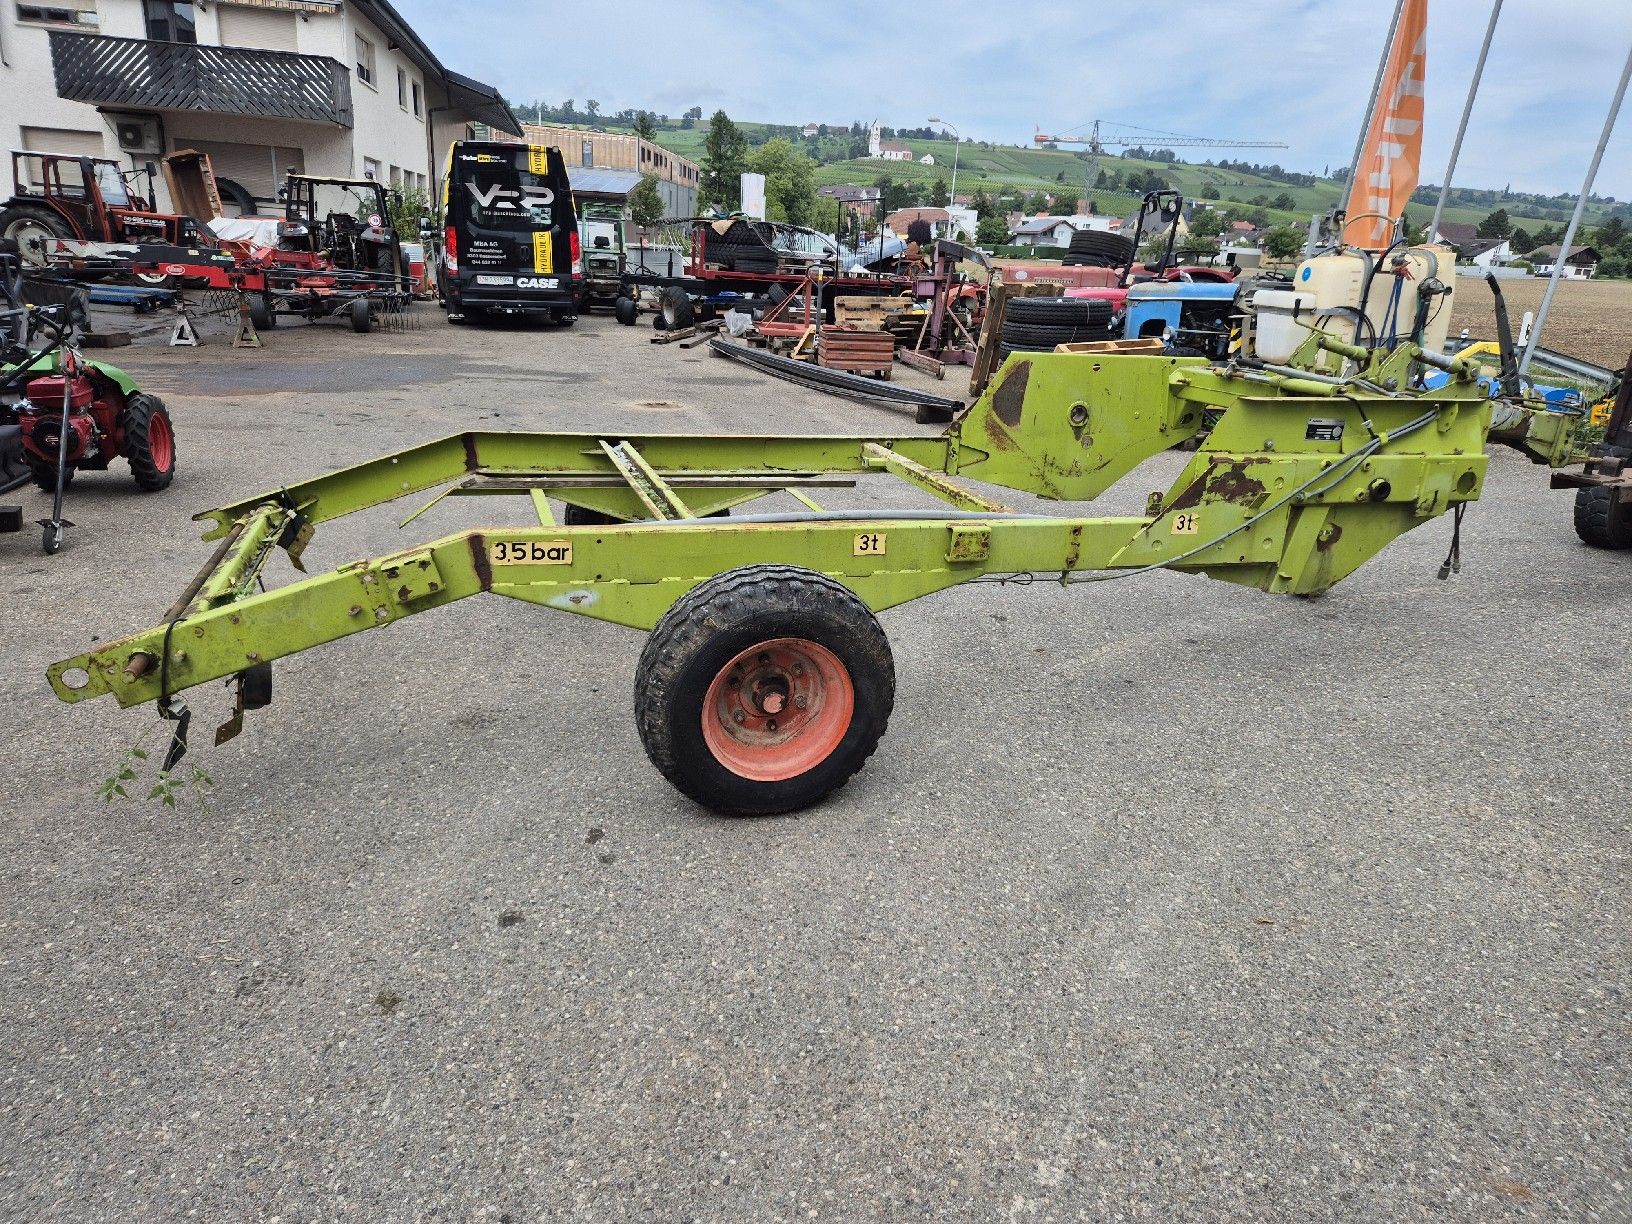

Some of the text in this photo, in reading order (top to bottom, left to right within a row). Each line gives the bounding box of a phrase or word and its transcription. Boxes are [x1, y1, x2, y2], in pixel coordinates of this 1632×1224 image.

[539, 232, 547, 272] HYDRAULIK
[516, 277, 559, 289] CASE
[1176, 514, 1193, 531] 3t
[859, 534, 879, 551] 3t
[495, 542, 570, 563] 3,5 bar
